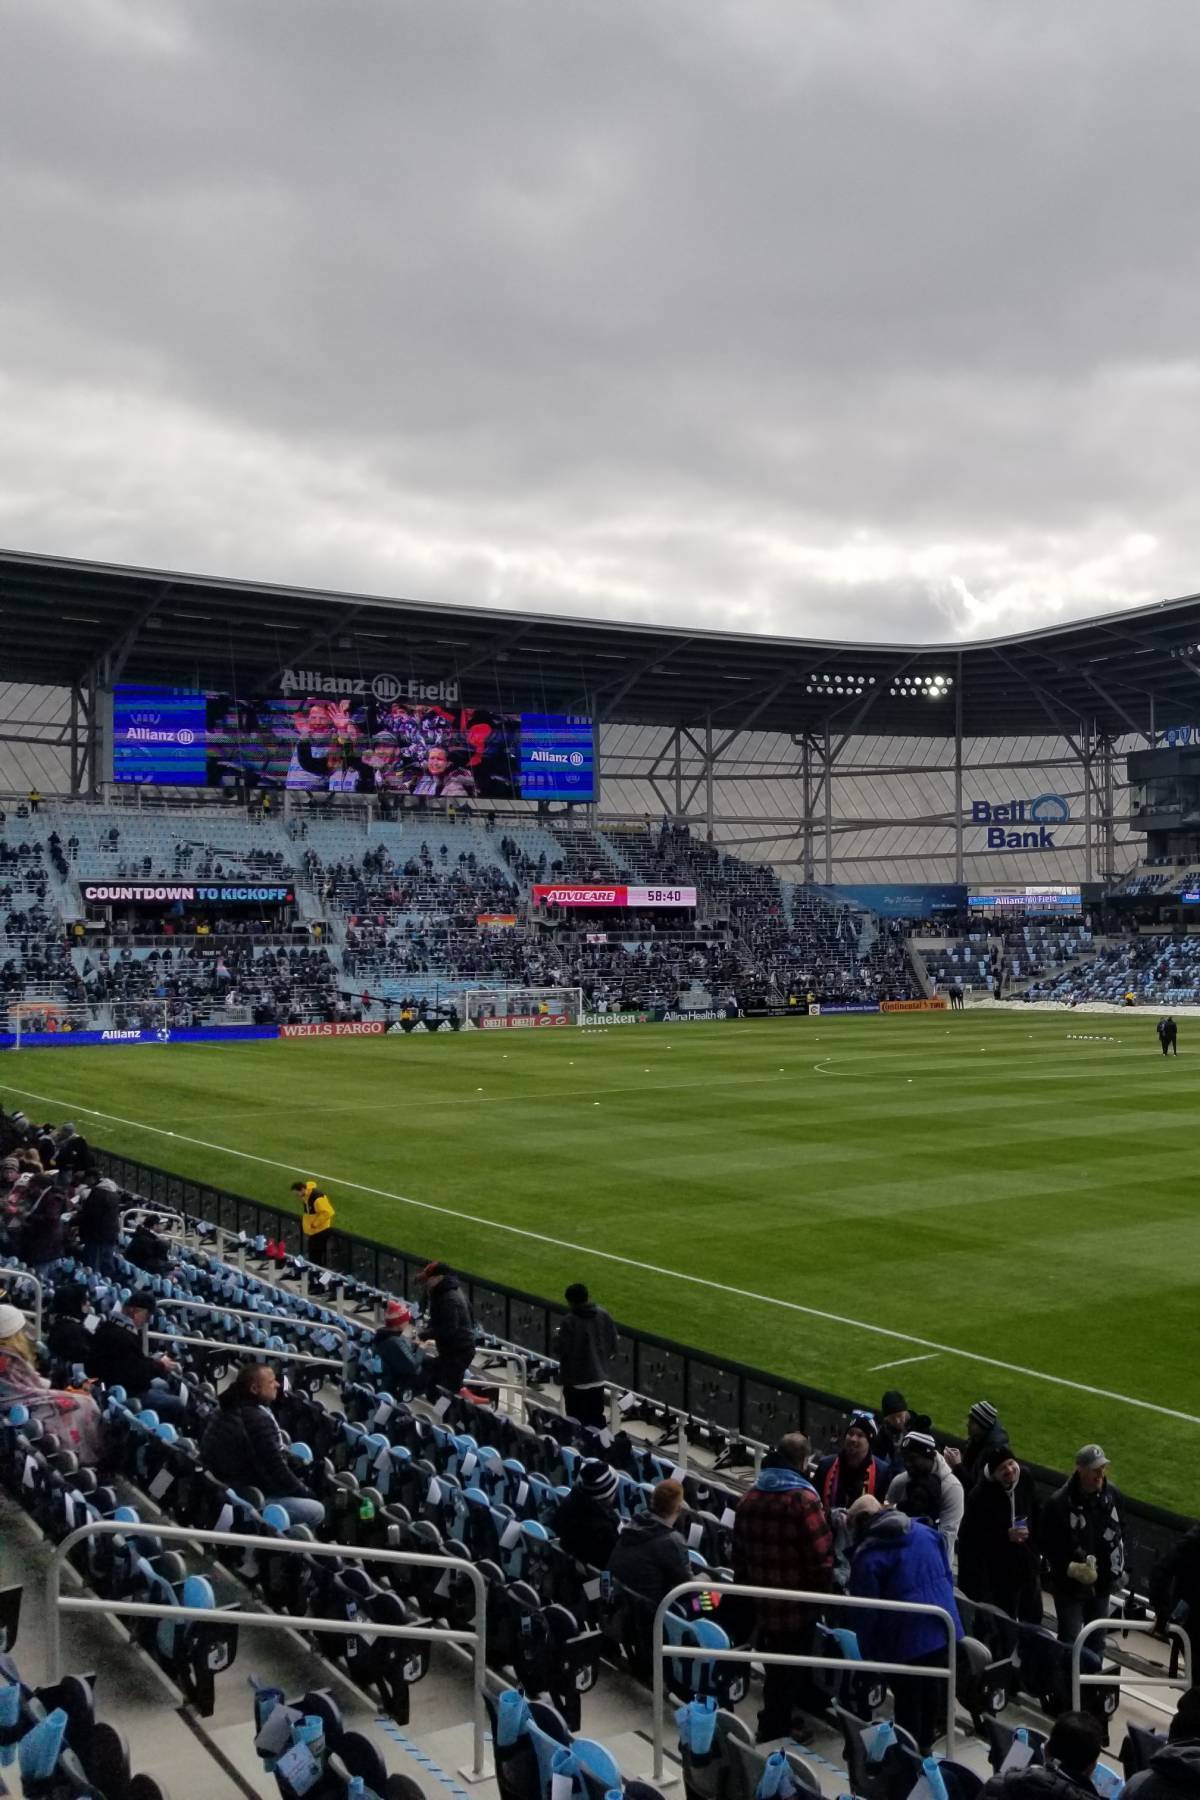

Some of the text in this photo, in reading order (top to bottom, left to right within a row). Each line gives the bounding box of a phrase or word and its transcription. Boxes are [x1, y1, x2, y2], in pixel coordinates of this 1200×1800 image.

[280, 669, 459, 701] Allianz Field
[126, 727, 174, 742] Allianz
[531, 751, 568, 763] Allianz
[972, 800, 1025, 822] Bell
[988, 826, 1055, 848] Bank
[85, 887, 194, 900] COUNTDOWN
[196, 887, 218, 900] TO
[549, 890, 616, 902] ADVOCARE
[648, 890, 681, 901] 58:40
[995, 897, 1025, 905] Allianz
[882, 1001, 921, 1012] Continental
[576, 1013, 635, 1025] Heineken
[101, 1030, 141, 1040] Allianz
[283, 1023, 382, 1036] WELLS FARGO
